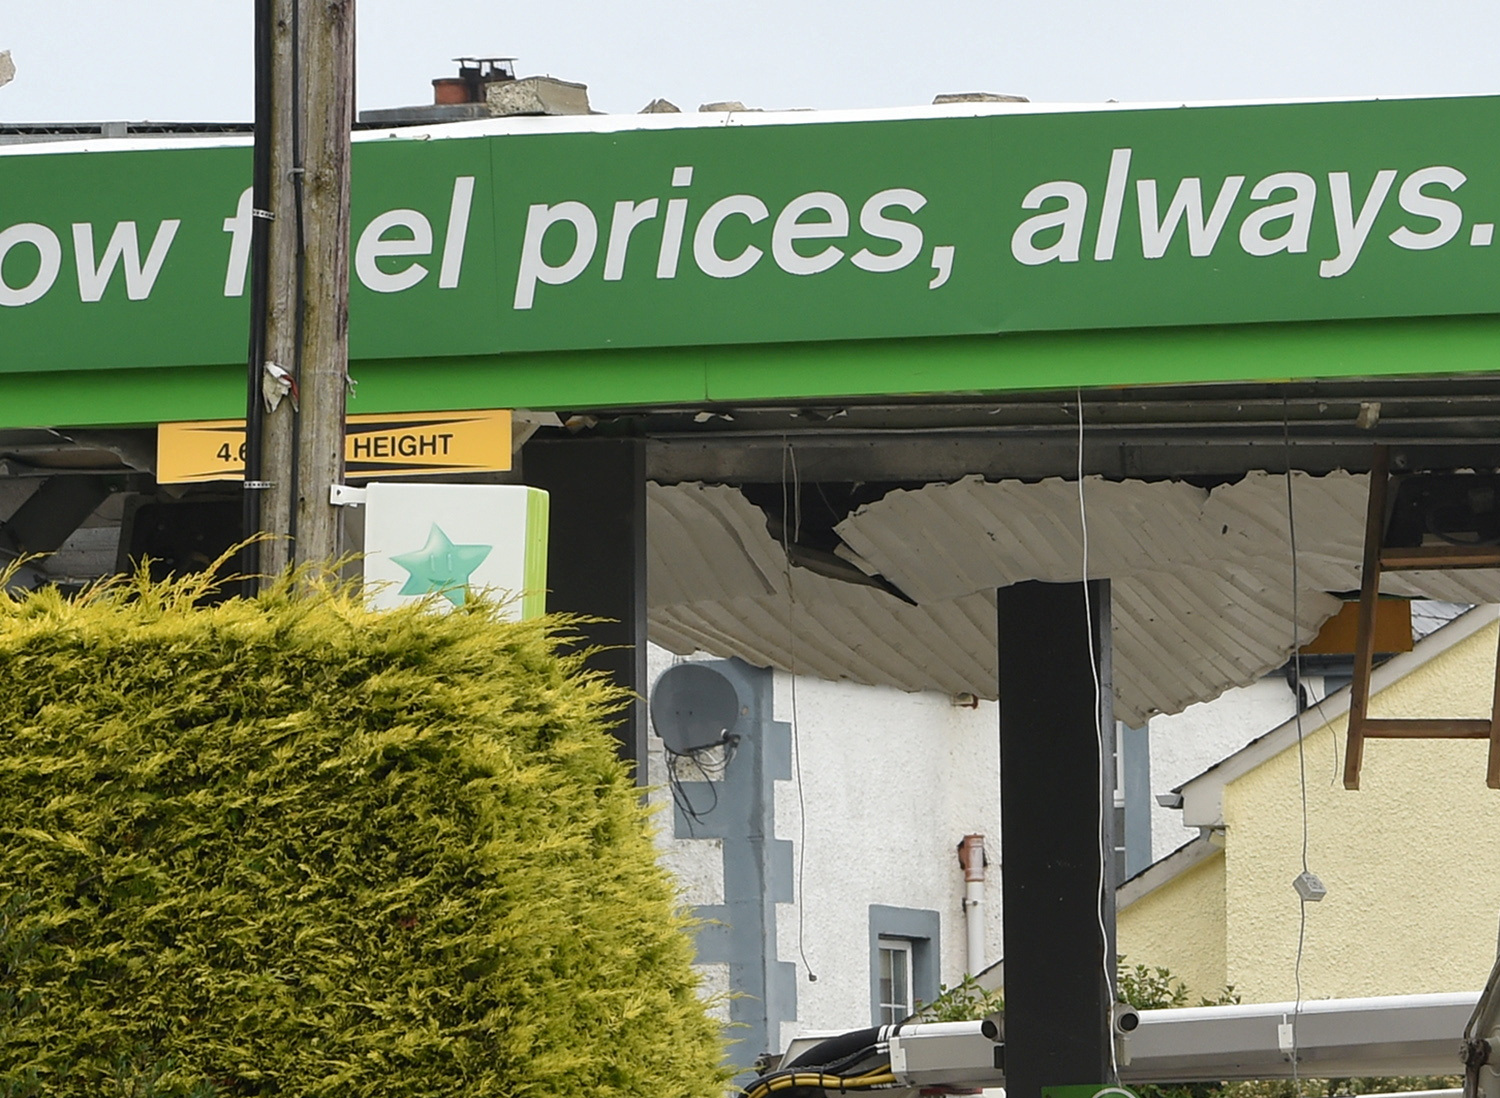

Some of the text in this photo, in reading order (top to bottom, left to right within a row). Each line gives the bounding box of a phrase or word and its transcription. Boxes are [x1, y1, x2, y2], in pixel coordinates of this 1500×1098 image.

[223, 175, 476, 298] fel
[514, 165, 955, 310] prices,
[1010, 148, 1496, 279] always.
[353, 433, 454, 458] HEIGHT
